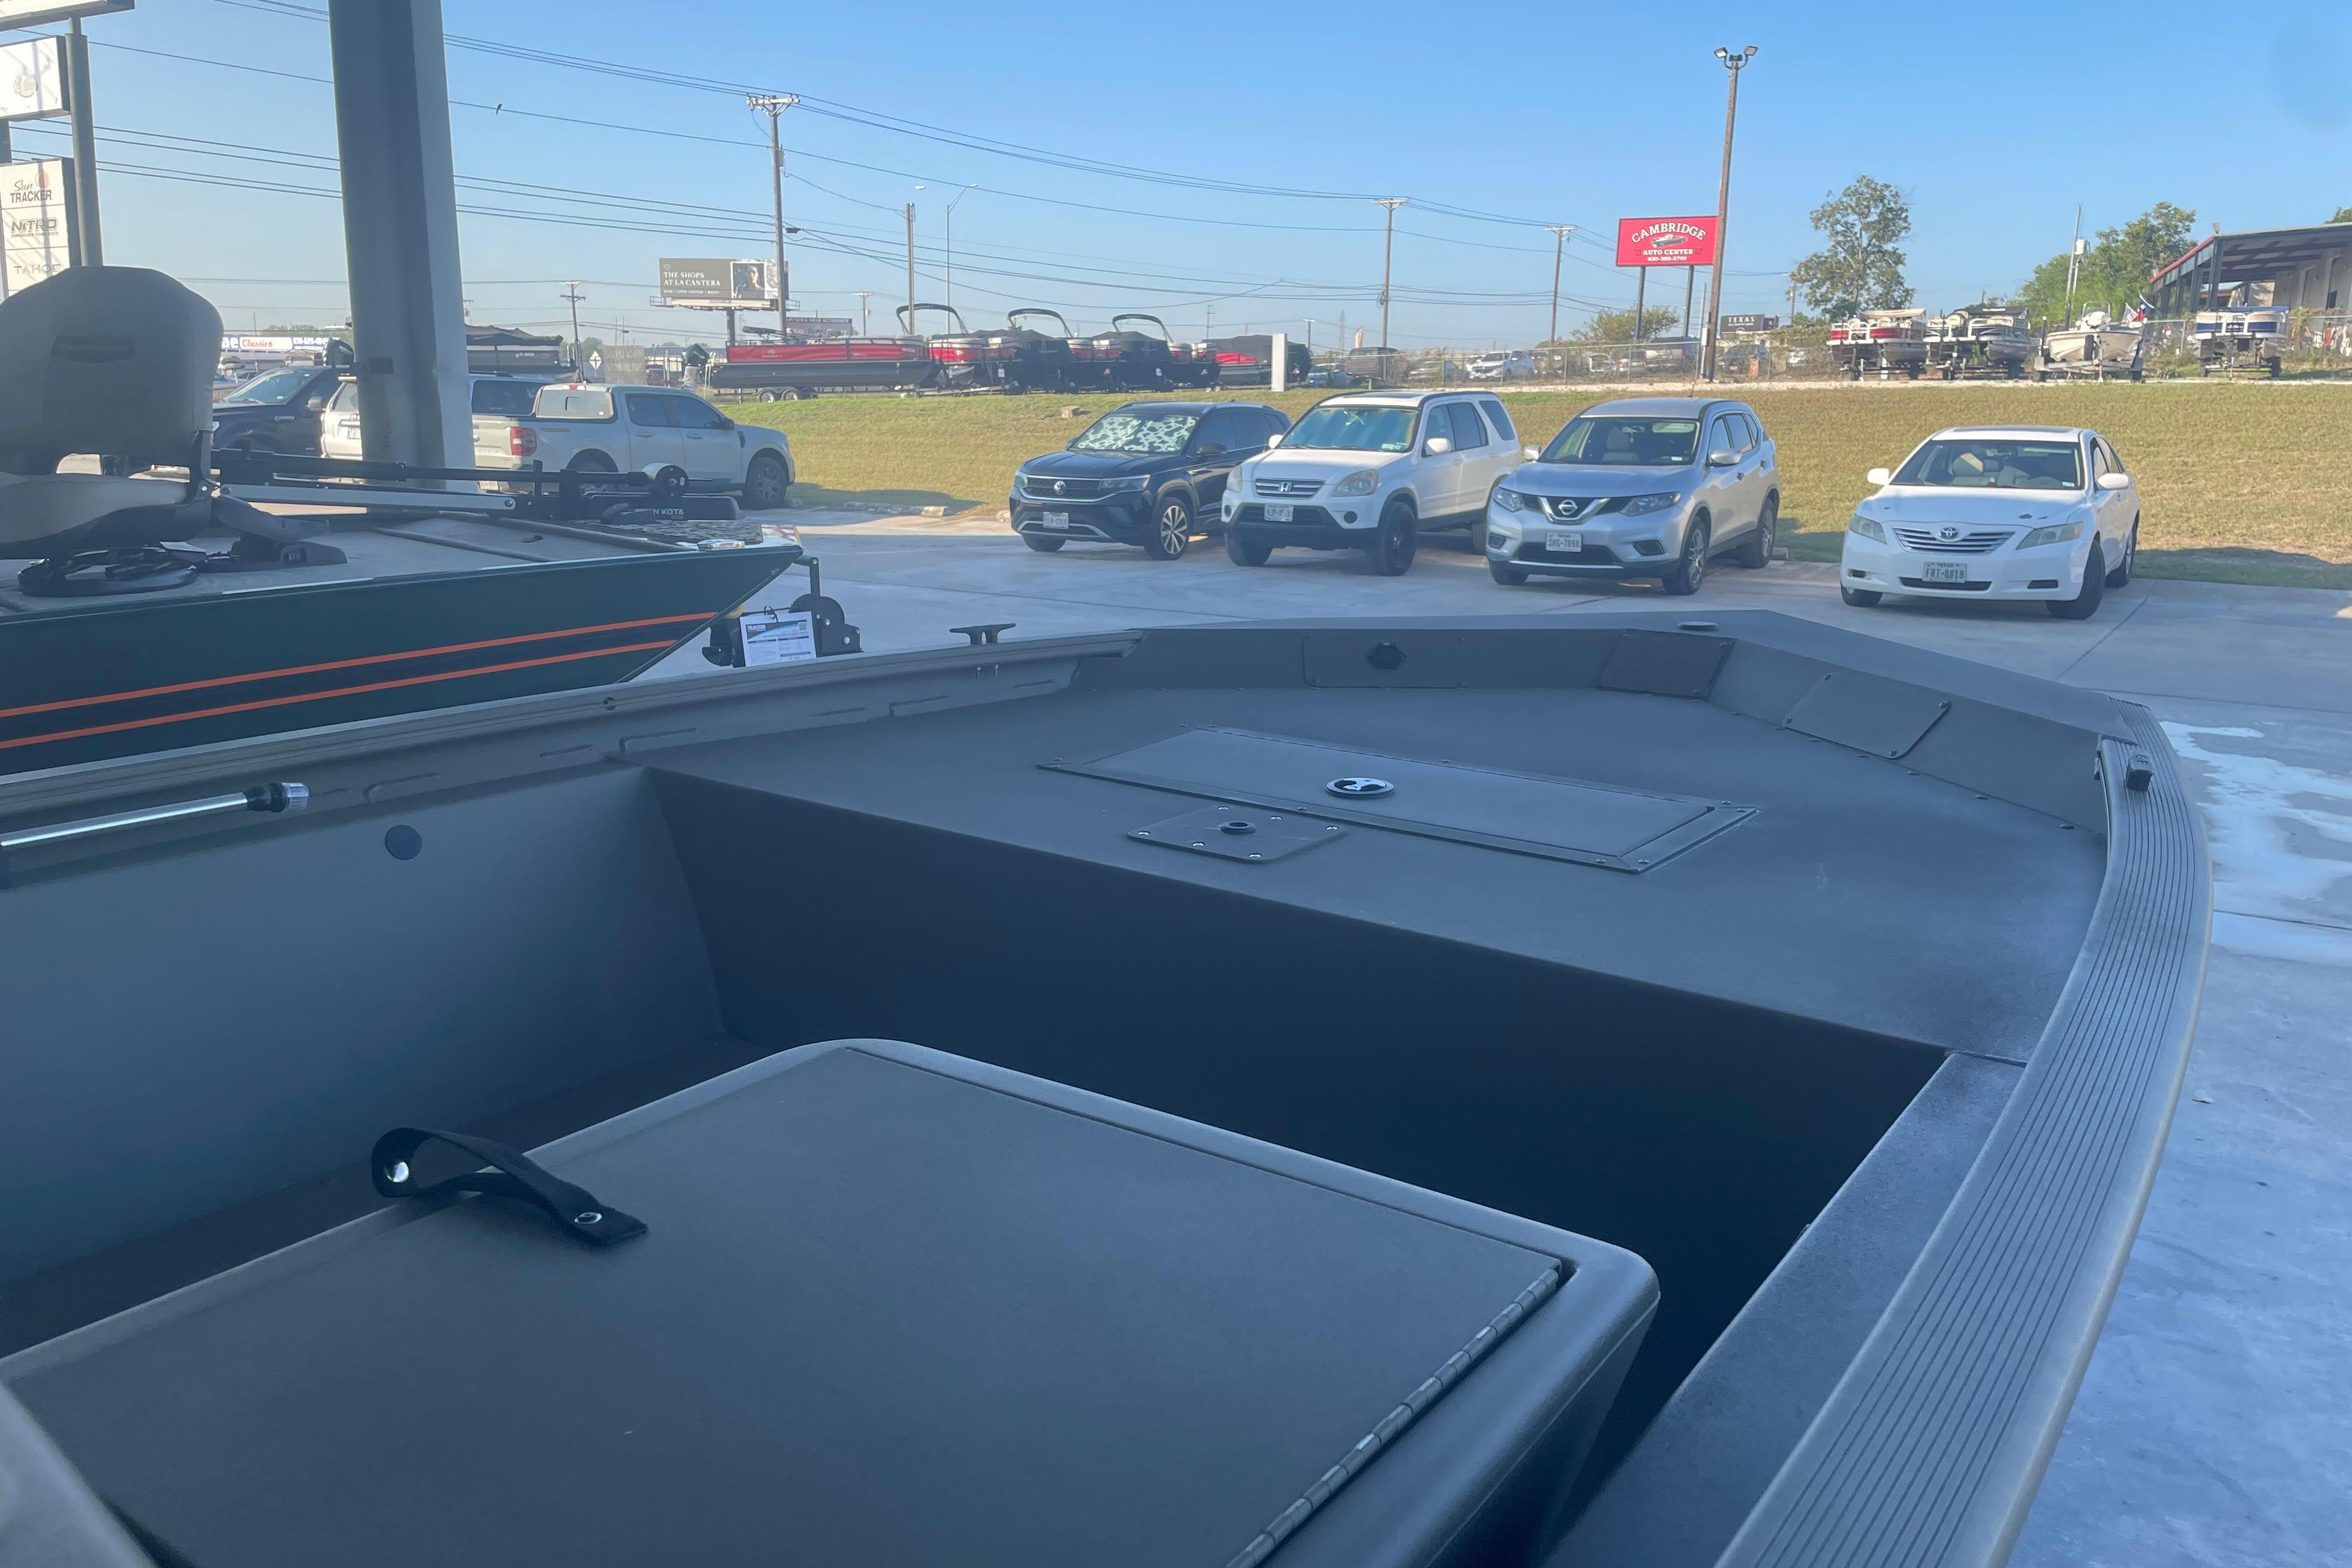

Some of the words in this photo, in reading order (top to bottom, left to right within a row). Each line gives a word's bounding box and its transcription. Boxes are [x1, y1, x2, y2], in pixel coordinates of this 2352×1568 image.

[10, 189, 52, 203] TRACKER
[1631, 222, 1707, 243] CAMBRIDGE
[13, 264, 61, 274] TAHOE
